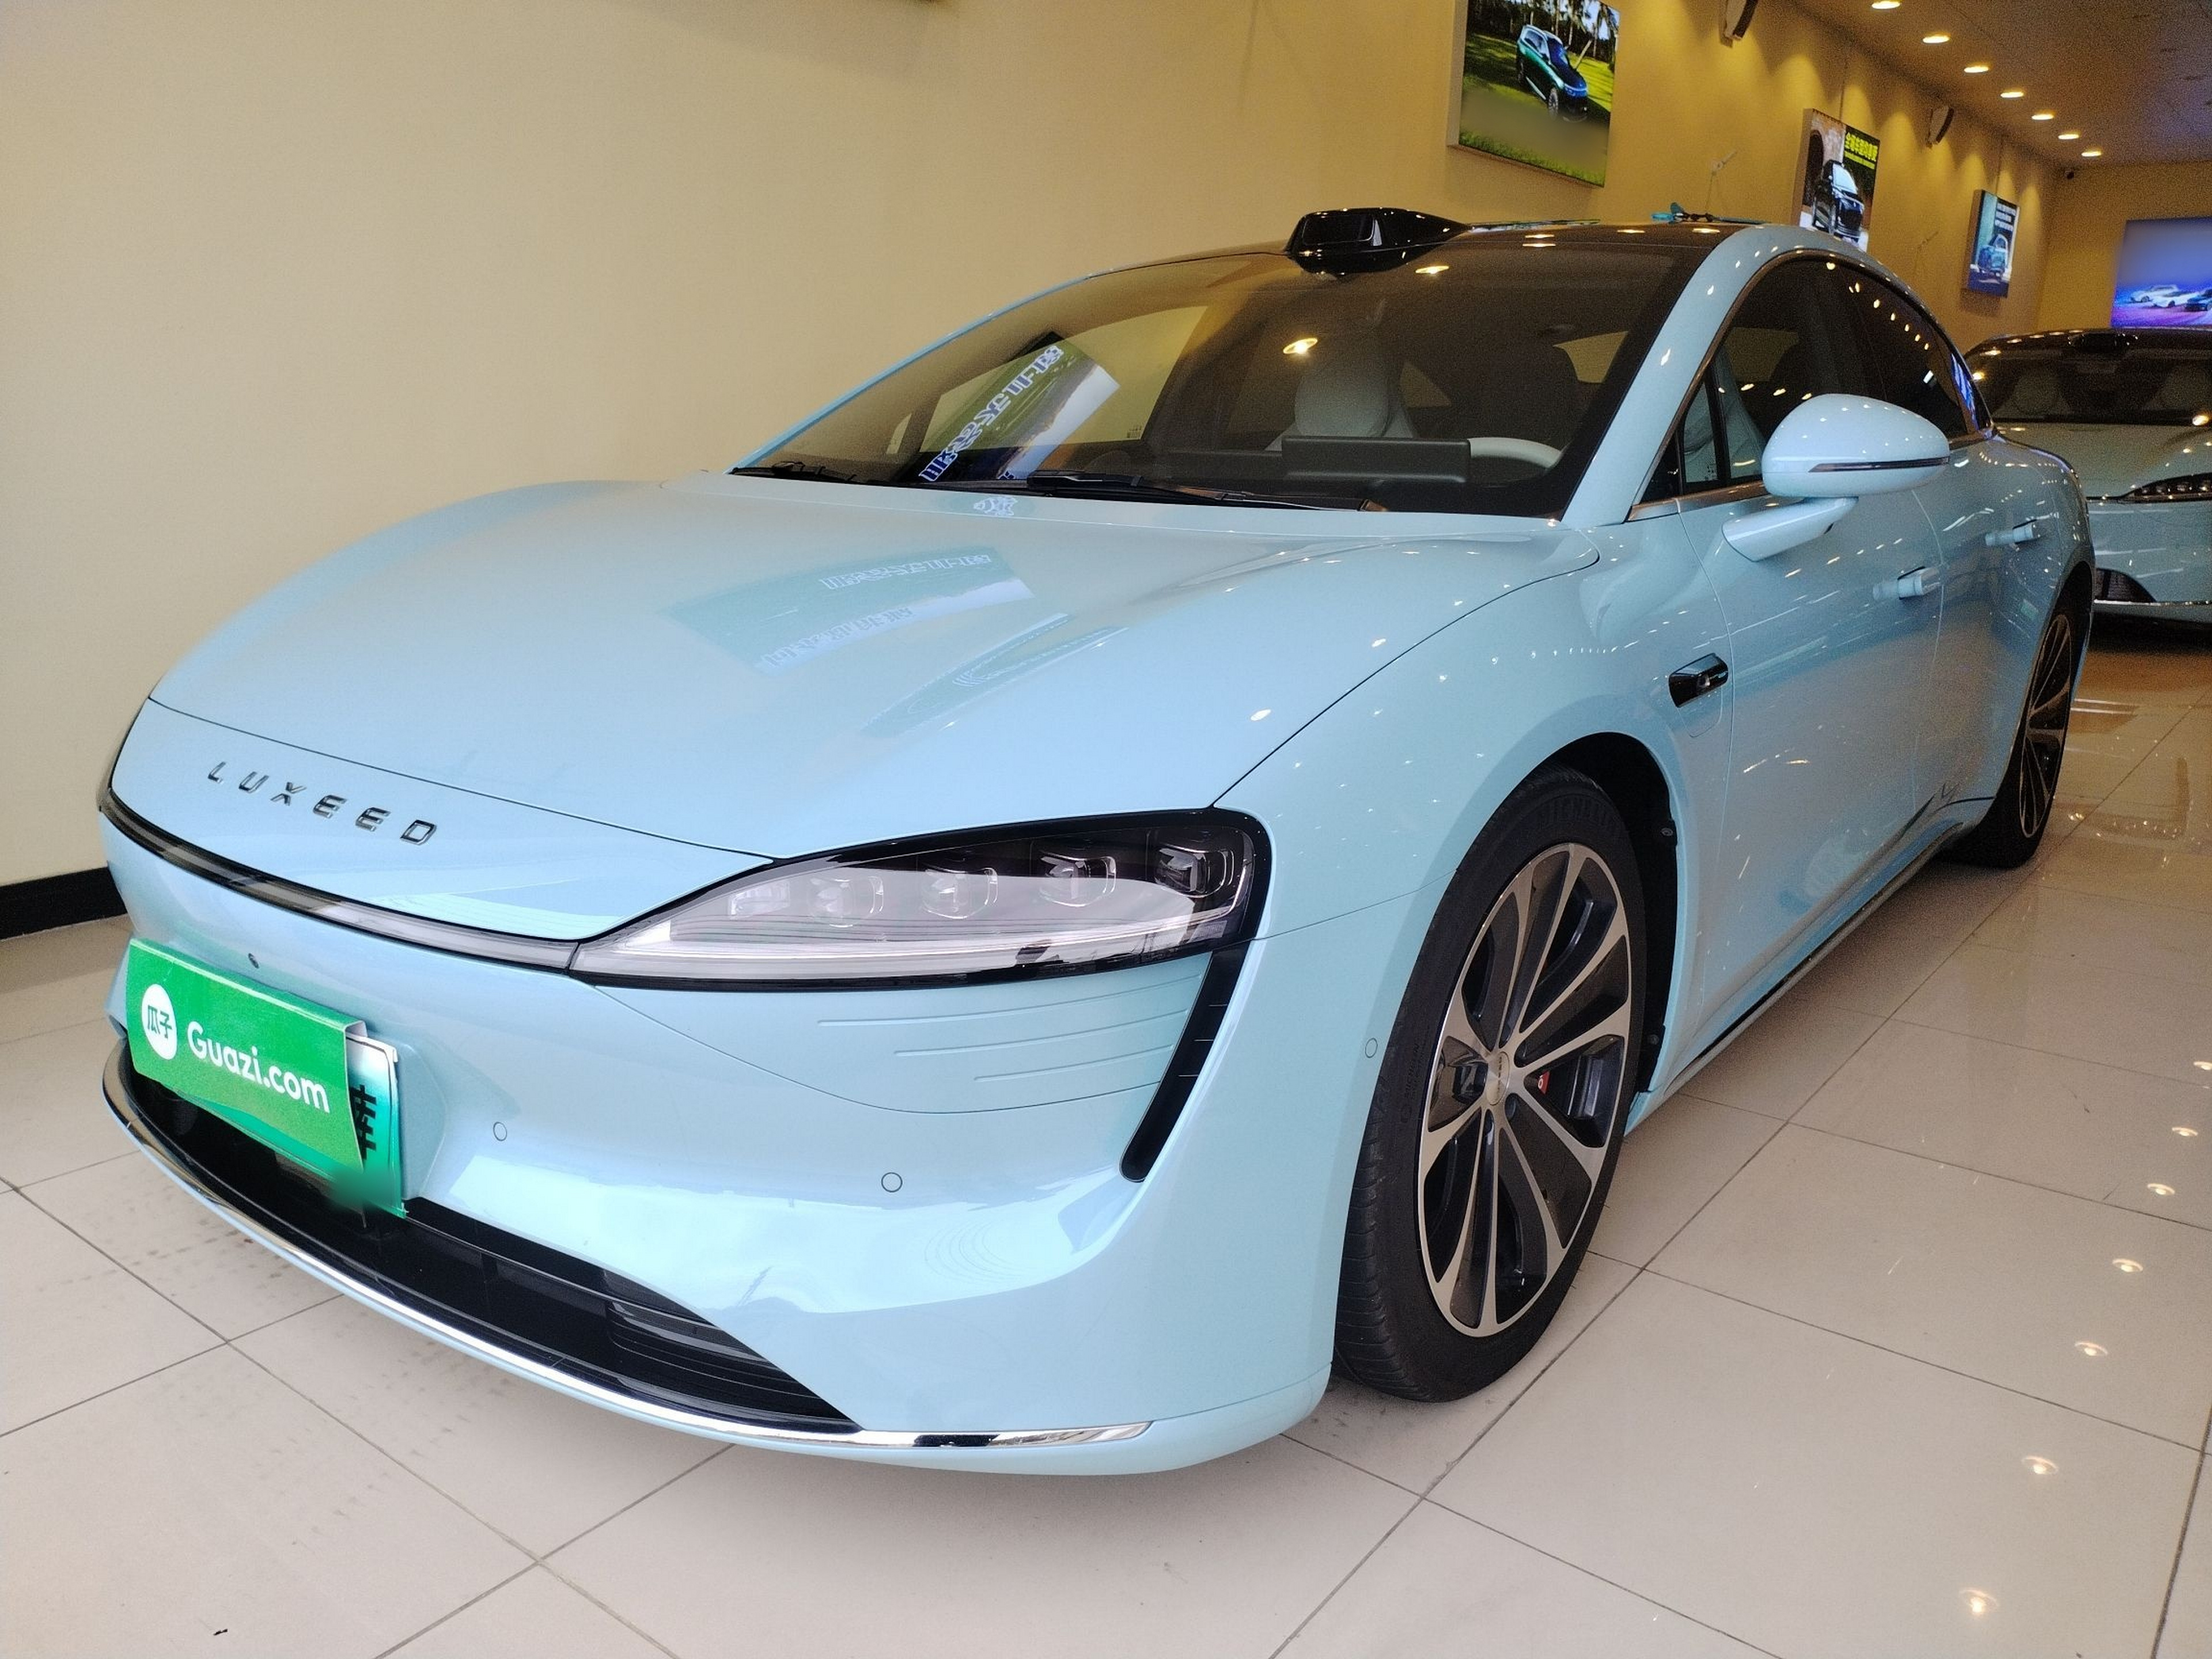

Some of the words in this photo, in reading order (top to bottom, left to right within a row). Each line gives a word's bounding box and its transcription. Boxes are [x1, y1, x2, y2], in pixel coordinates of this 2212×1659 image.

[207, 761, 438, 846] LUXEED
[146, 1004, 173, 1040] 瓜子
[187, 1020, 331, 1114] Guazi.com
